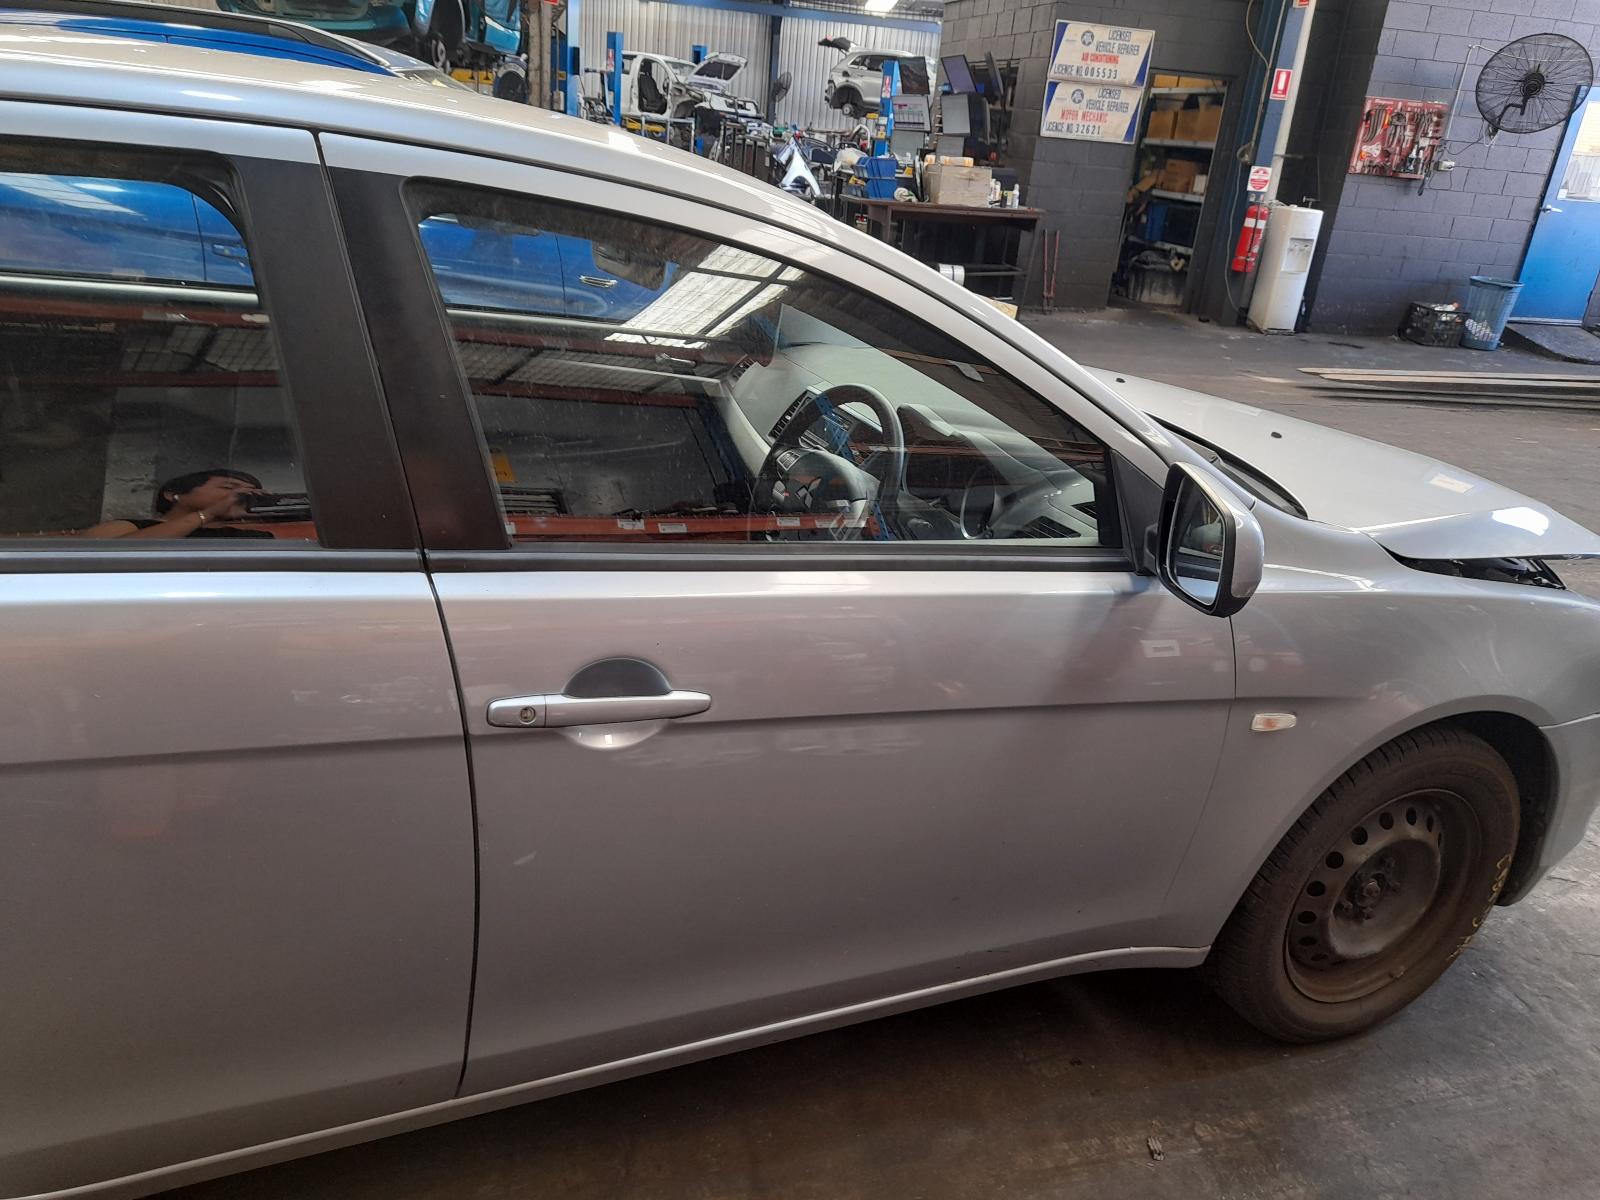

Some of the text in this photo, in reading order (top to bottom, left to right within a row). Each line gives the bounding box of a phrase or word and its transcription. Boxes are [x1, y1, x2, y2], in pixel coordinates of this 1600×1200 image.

[1095, 41, 1117, 53] VEHICLE
[1084, 67, 1118, 79] 005533
[1086, 99, 1105, 111] VEHICLE
[1074, 124, 1100, 135] 32621
